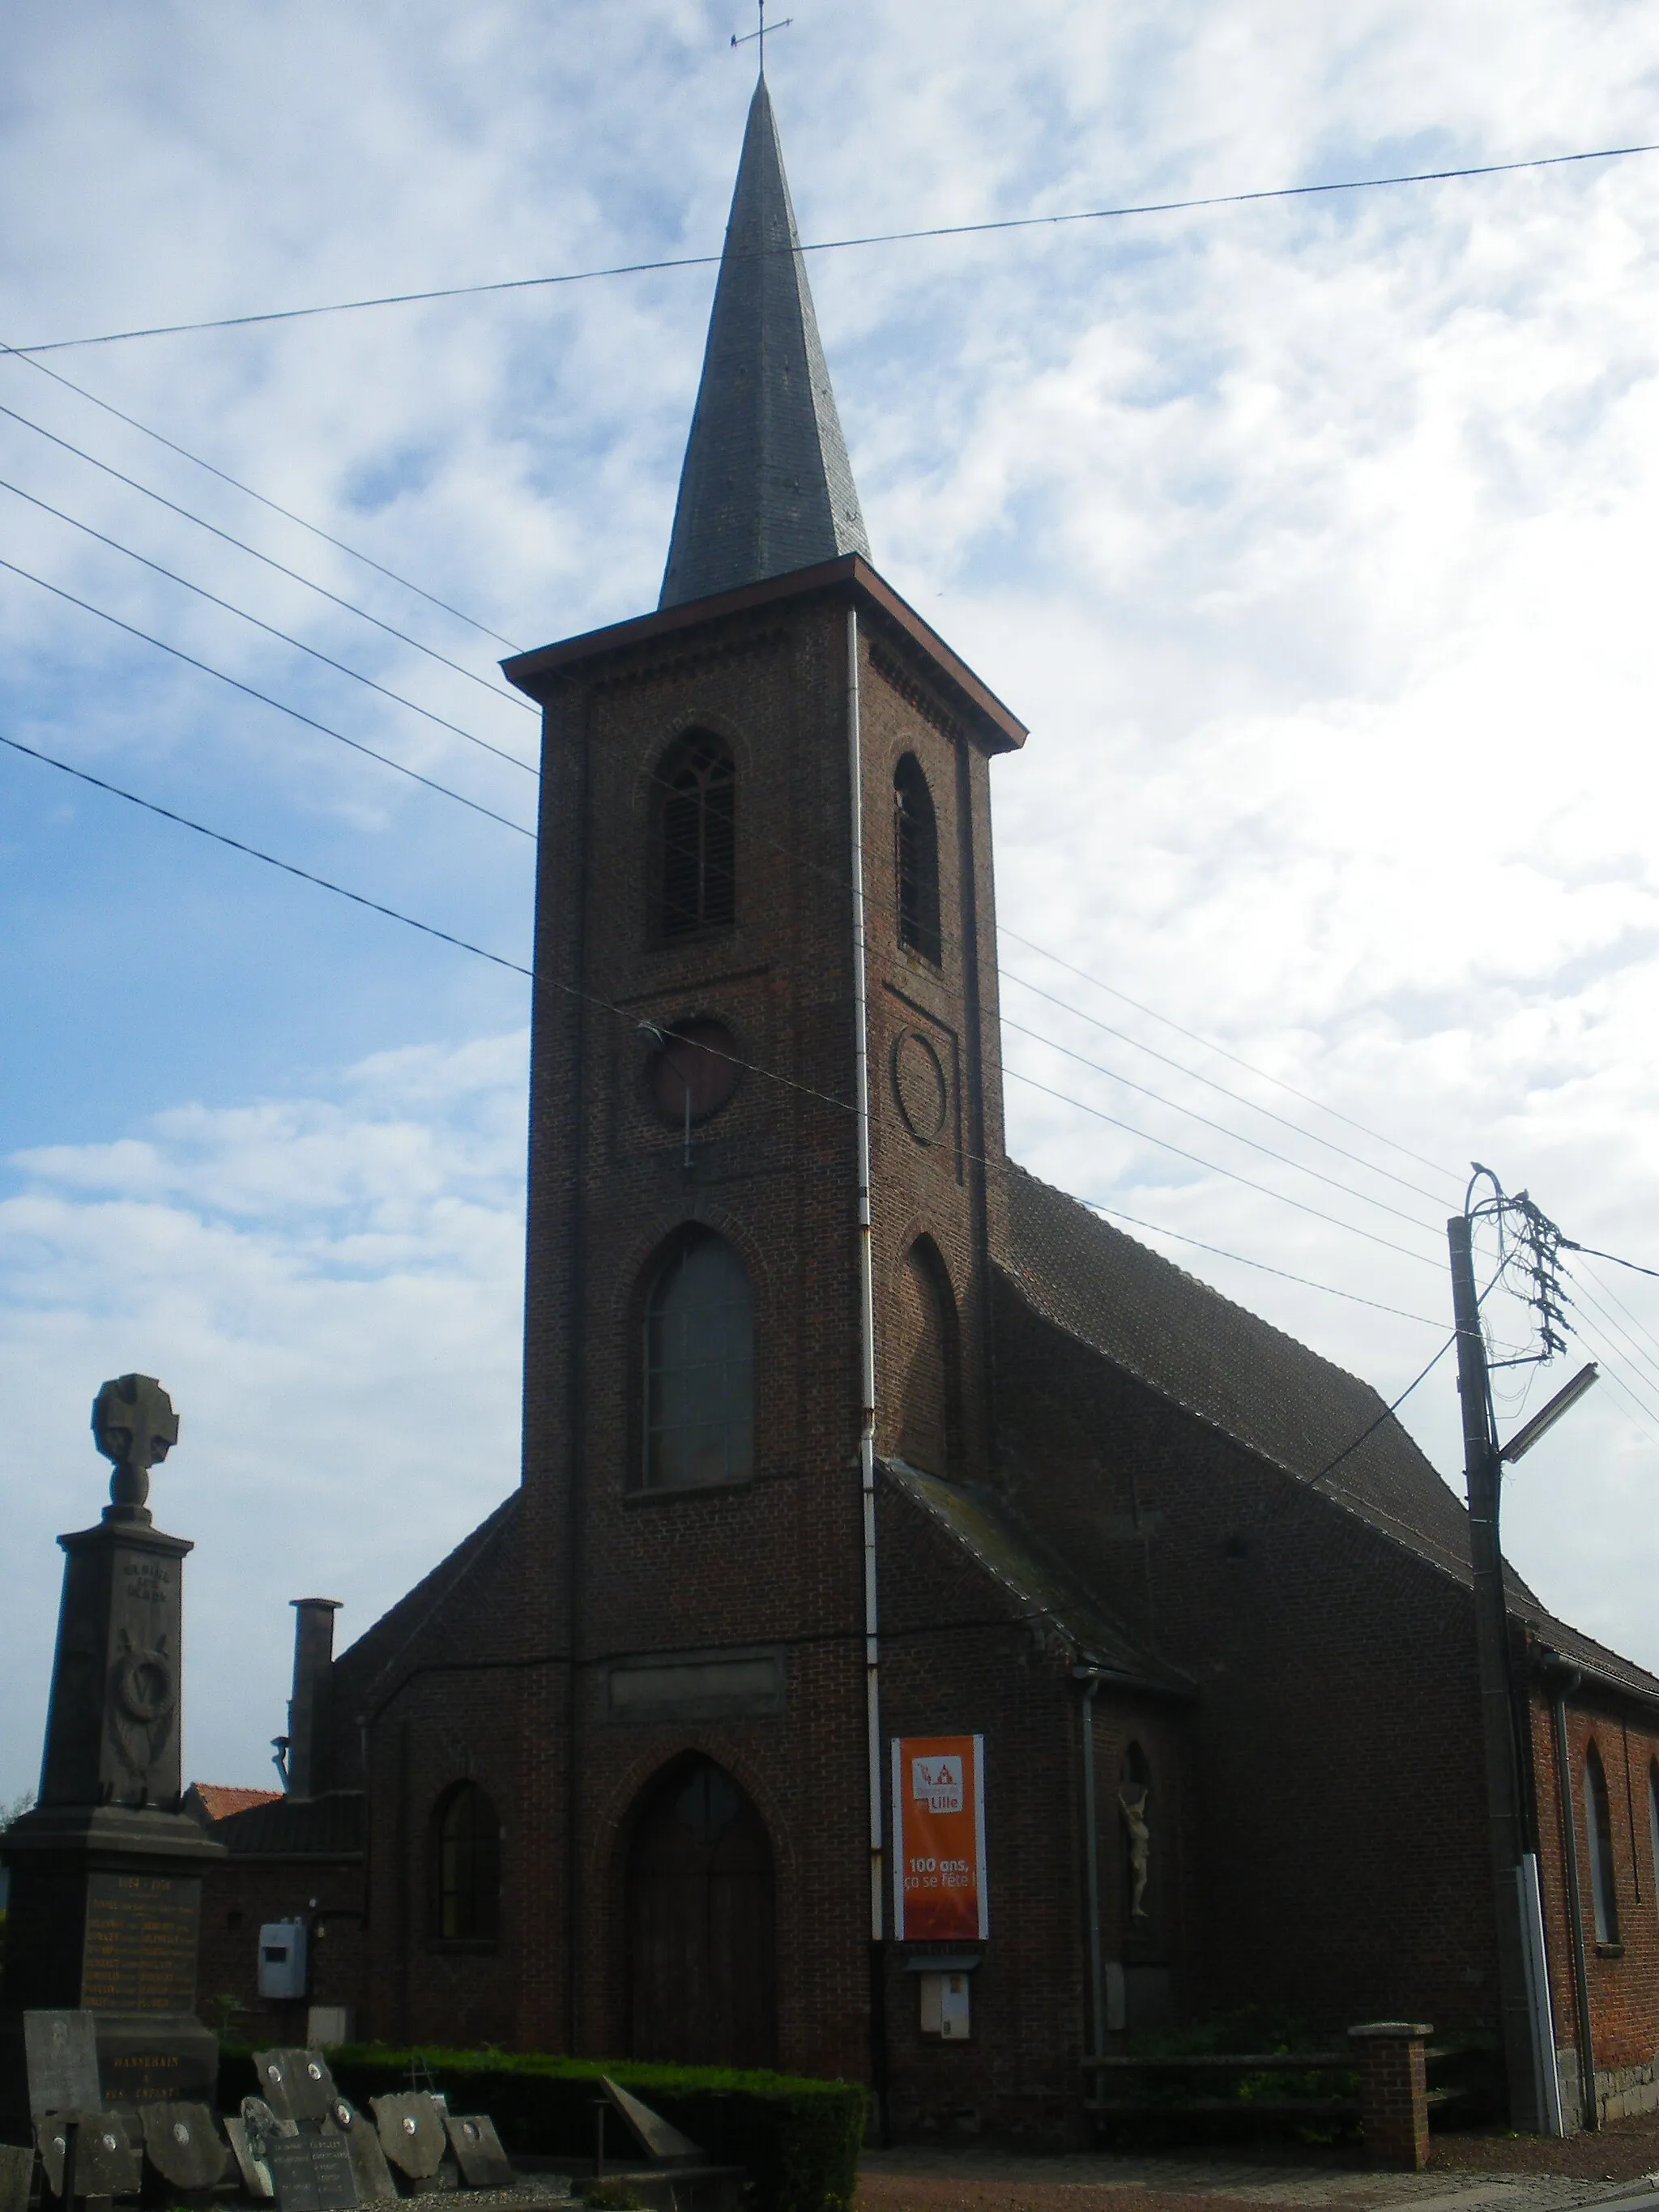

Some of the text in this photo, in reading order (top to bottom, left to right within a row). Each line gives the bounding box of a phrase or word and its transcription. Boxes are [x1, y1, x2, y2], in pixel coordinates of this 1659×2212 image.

[932, 1796, 958, 1809] Lille
[909, 1857, 970, 1873] 100 ans,
[904, 1876, 919, 1892] ça
[923, 1876, 938, 1888] se
[940, 1872, 969, 1887] fête
